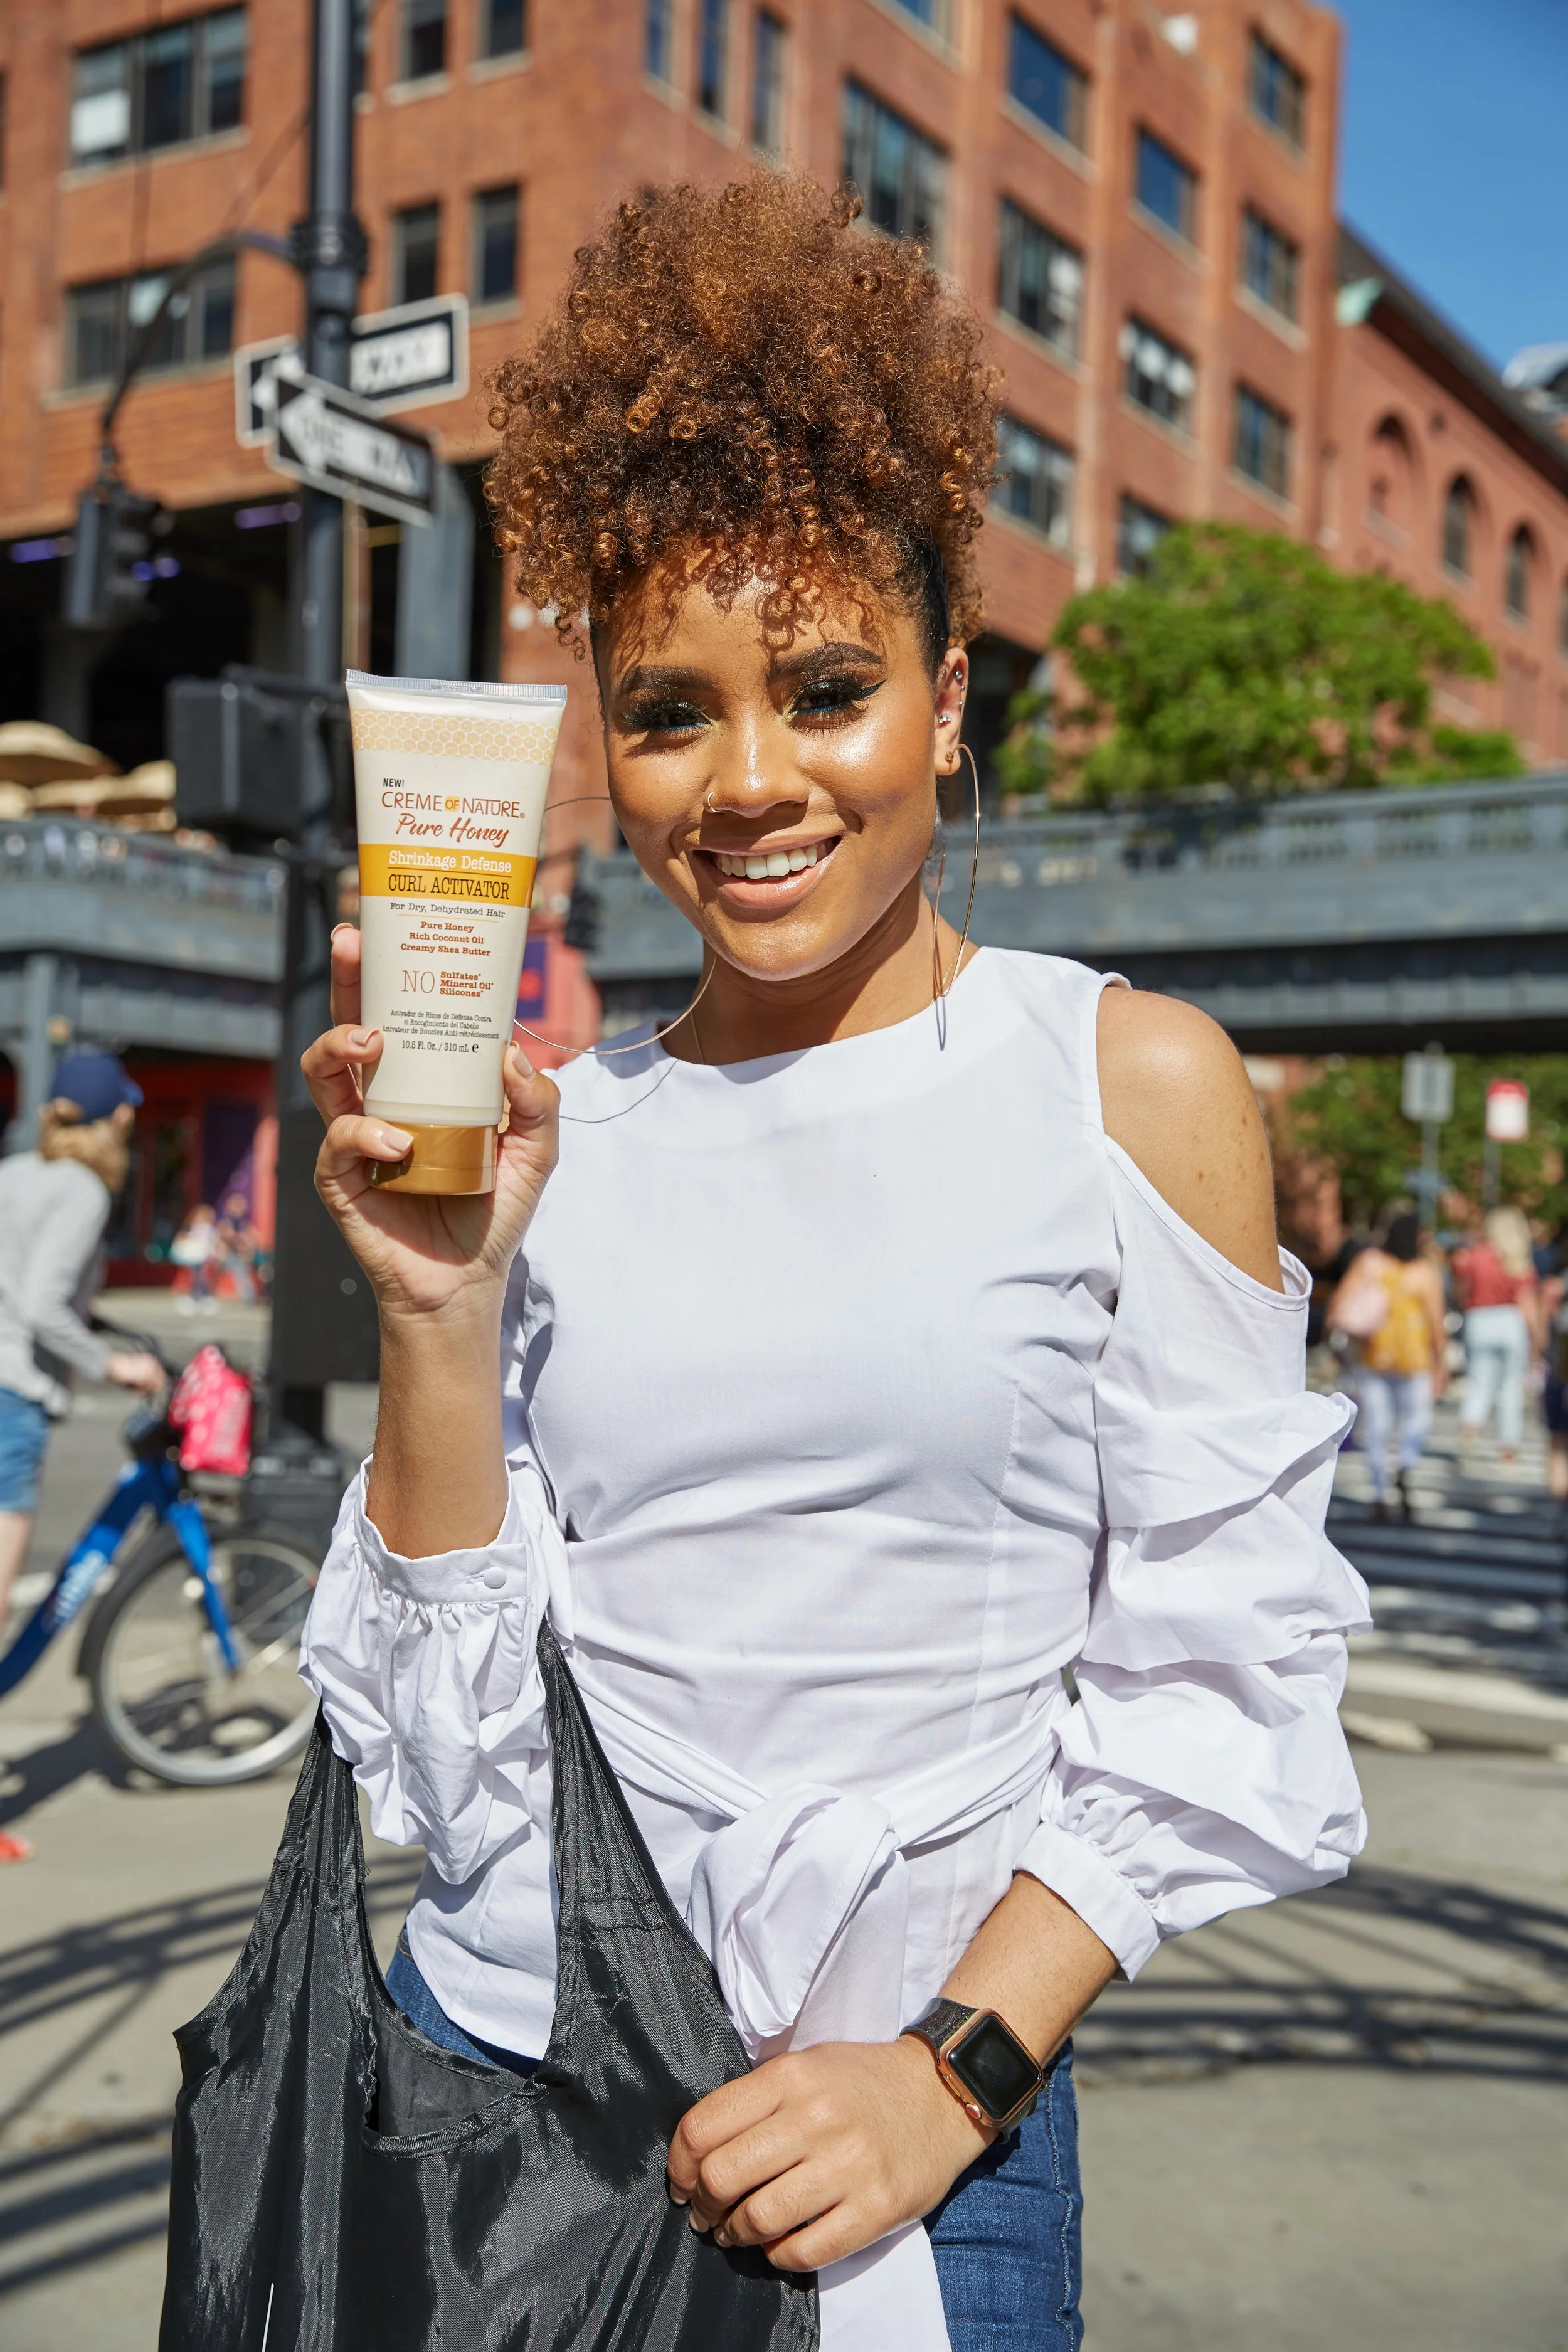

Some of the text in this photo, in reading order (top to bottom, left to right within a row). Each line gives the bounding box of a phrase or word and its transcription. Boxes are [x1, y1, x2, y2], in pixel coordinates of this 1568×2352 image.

[383, 778, 404, 787] NEW!
[382, 792, 442, 811] CREME
[445, 799, 459, 810] OF
[396, 813, 509, 848] Pure Honey
[389, 850, 511, 872] Shrinkage Defense
[389, 874, 509, 899] CURL ACTIVATOR
[409, 903, 426, 913] Dry,
[431, 905, 483, 915] Dehydrated
[487, 909, 505, 918] Hair
[445, 923, 474, 933] Honey
[433, 934, 469, 943] Coconut
[401, 944, 435, 953] Creamy
[462, 948, 490, 956] Butter
[401, 970, 435, 993] NO
[440, 980, 477, 988] Mineral
[383, 1025, 410, 1034] Activateur
[410, 1020, 448, 1028] Encogimiento
[402, 1040, 415, 1049] 10.5
[427, 1042, 437, 1051] Oz.
[438, 1042, 442, 1051] /
[445, 1042, 457, 1052] 310
[459, 1044, 469, 1052] mL
